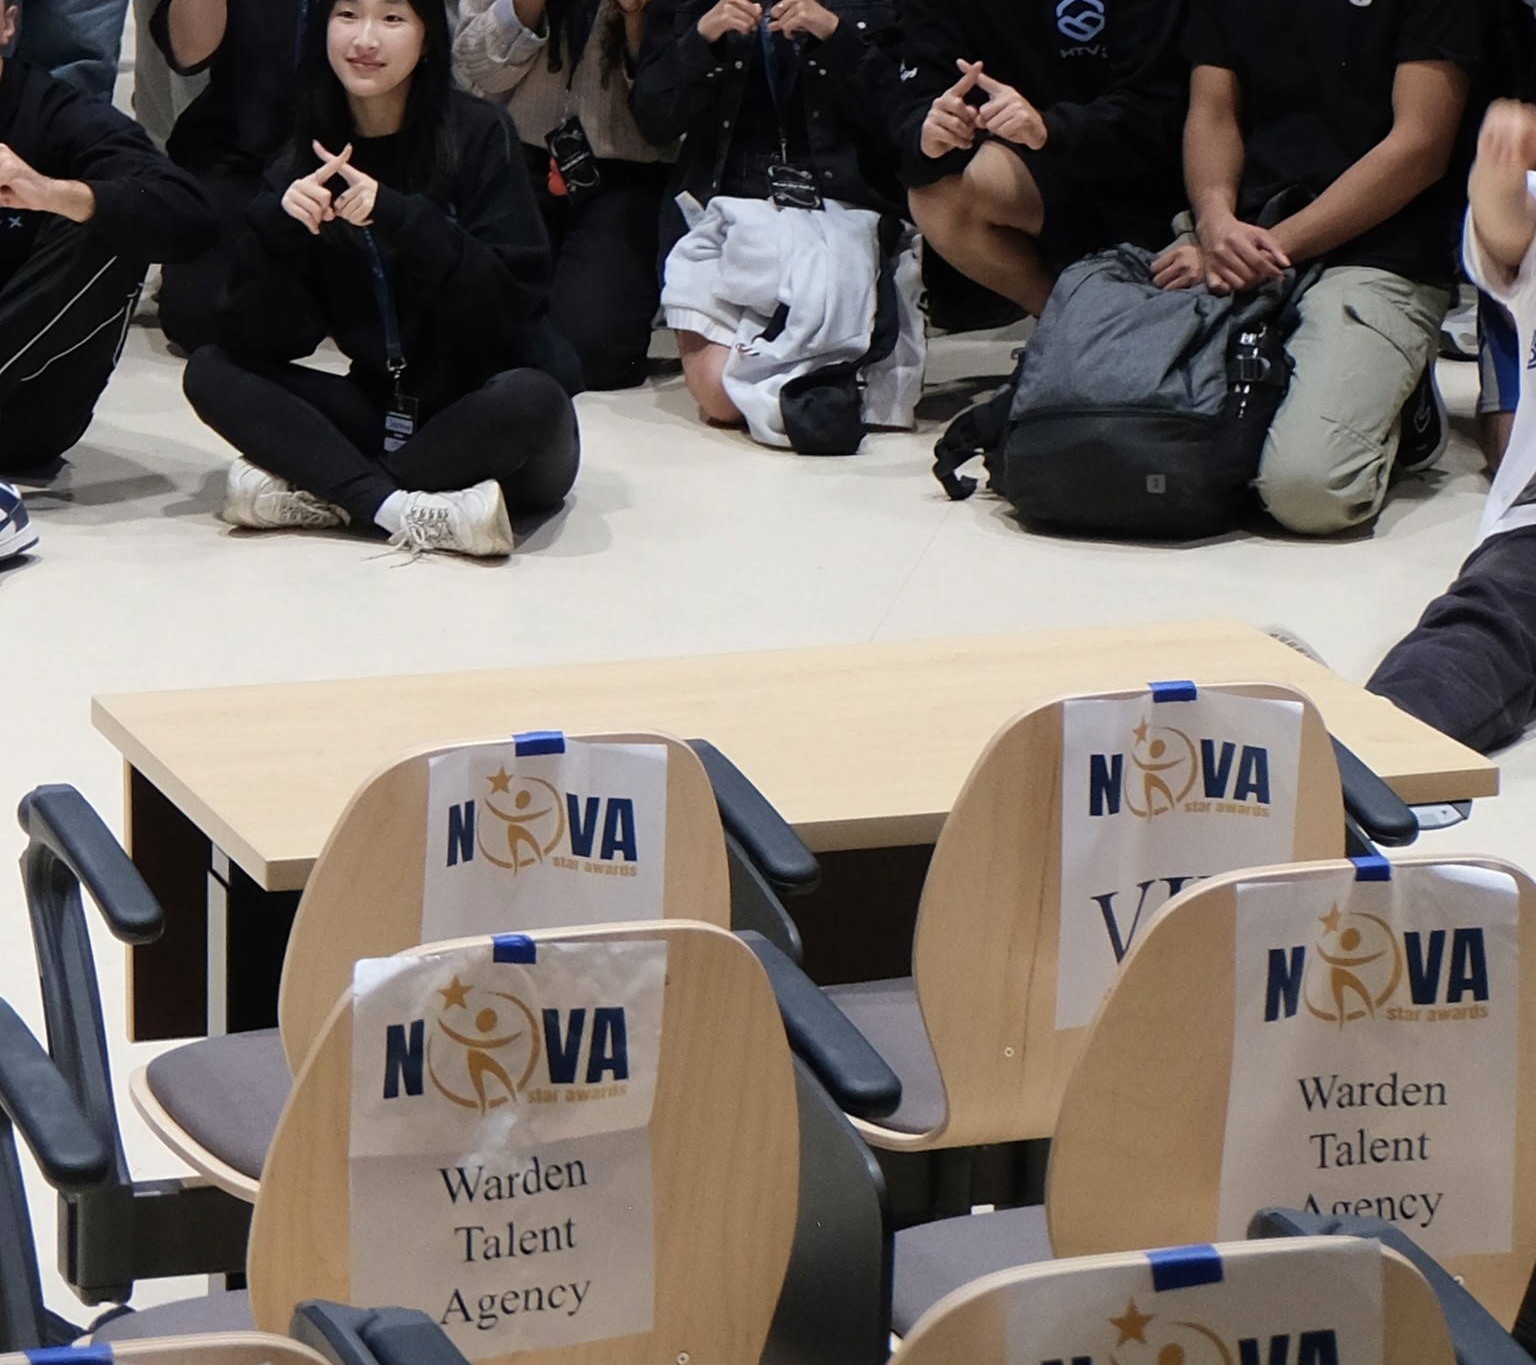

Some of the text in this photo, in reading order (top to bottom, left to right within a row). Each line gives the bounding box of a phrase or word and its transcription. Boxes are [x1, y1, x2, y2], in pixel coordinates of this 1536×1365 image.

[8, 216, 23, 229] X
[1184, 799, 1270, 818] star awards
[552, 854, 638, 877] star awards
[1386, 1004, 1489, 1023] star awards
[527, 1084, 628, 1104] star awards
[1298, 1073, 1448, 1112] Warden
[1310, 1129, 1431, 1169] Talent
[441, 1156, 589, 1206] Warden
[454, 1217, 577, 1264] Talent
[440, 1279, 592, 1331] Agency
